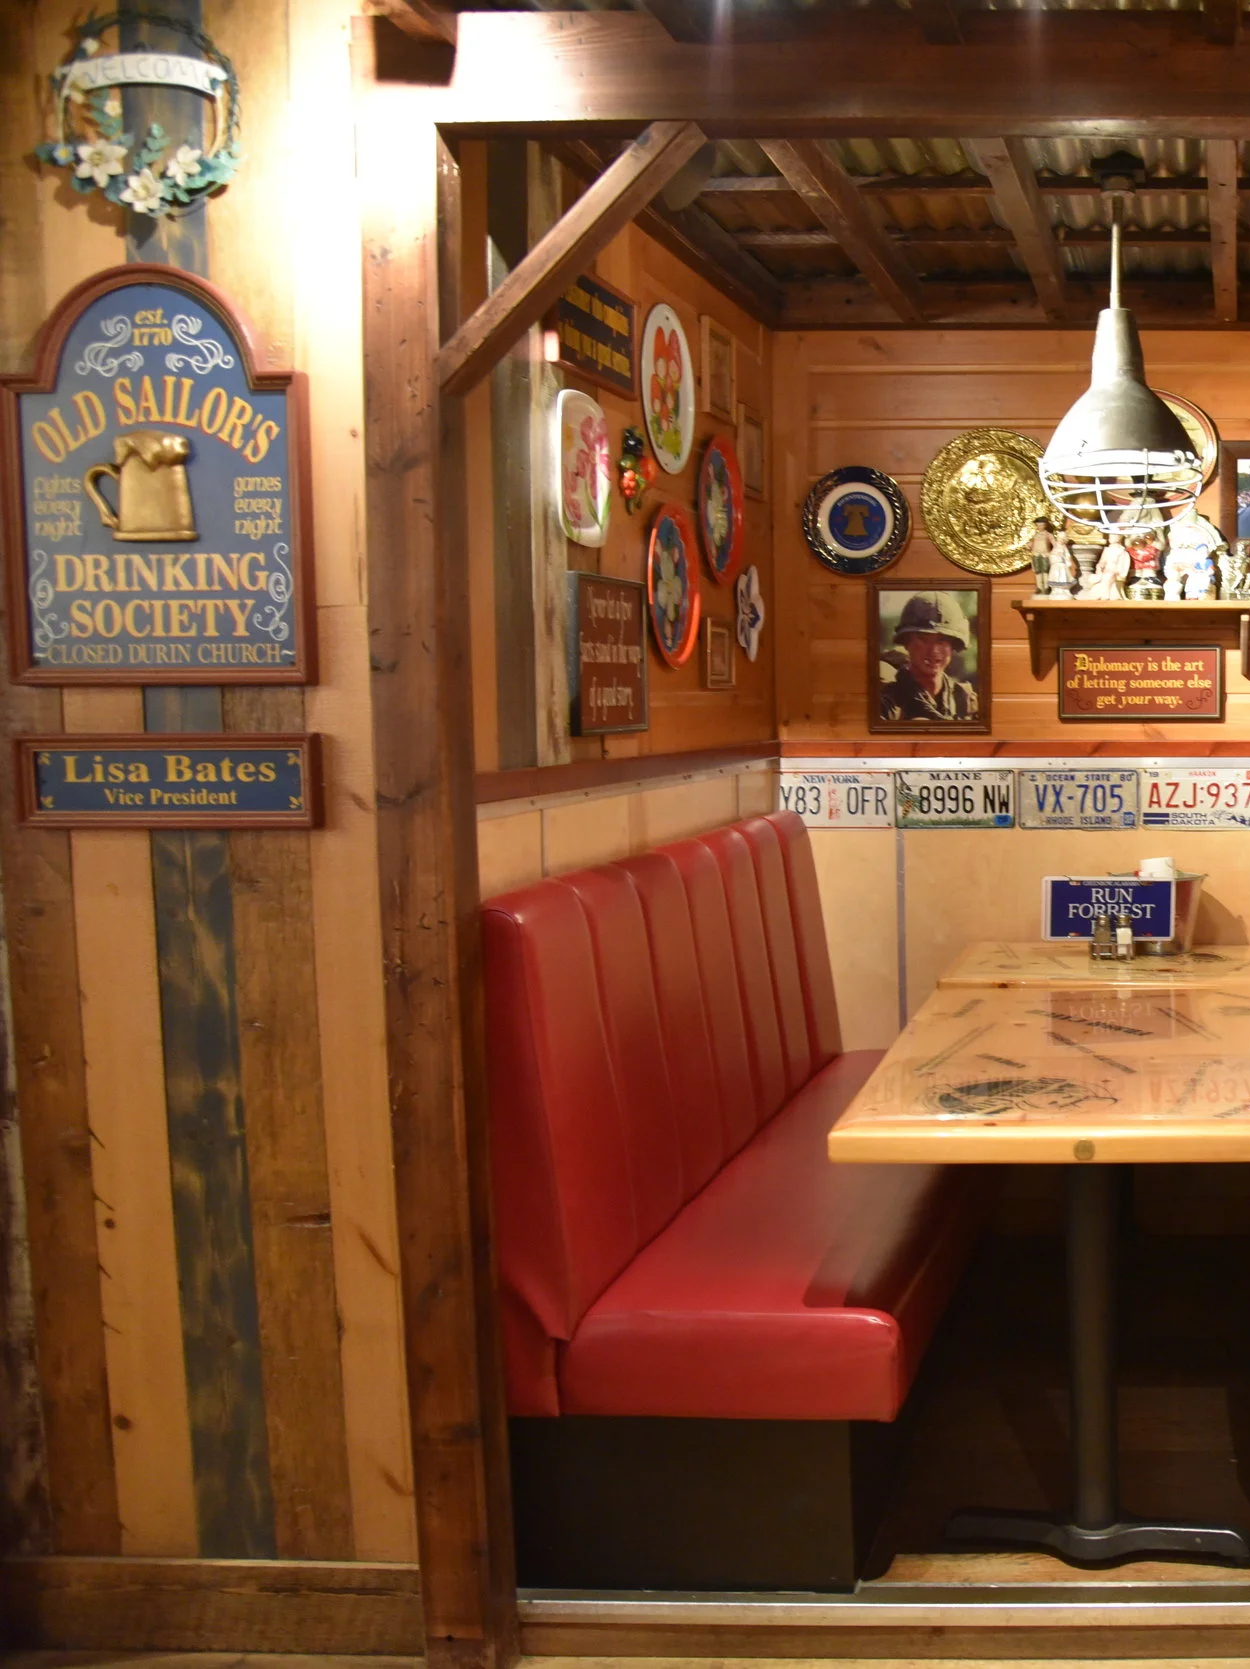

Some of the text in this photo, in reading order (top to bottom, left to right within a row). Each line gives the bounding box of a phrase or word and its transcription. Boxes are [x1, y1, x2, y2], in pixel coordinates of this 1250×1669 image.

[135, 308, 167, 325] est.
[132, 327, 173, 346] 1770
[32, 375, 281, 464] OLD SAILOR'S
[233, 476, 282, 499] games
[35, 517, 83, 541] night
[234, 517, 283, 540] night
[53, 552, 269, 593] DRINKING
[69, 599, 256, 638] SOCIETY
[49, 643, 282, 665] CLOSED DURIN CHURCH
[1073, 653, 1204, 675] Diplomacy is the art
[1067, 674, 1212, 692] of letting someone else
[1096, 695, 1183, 708] get your way.
[63, 754, 277, 783] Lisa Bates
[803, 774, 860, 784] NEW YORK
[930, 773, 982, 781] MAINE
[103, 787, 238, 806] Vice President
[781, 785, 821, 815] Y83
[919, 785, 1010, 814] 8996 NW
[1035, 783, 1124, 813] VX-705
[1046, 817, 1112, 825] RHODE ISLAND
[1091, 888, 1134, 903] RUN
[1067, 903, 1156, 919] FORREST
